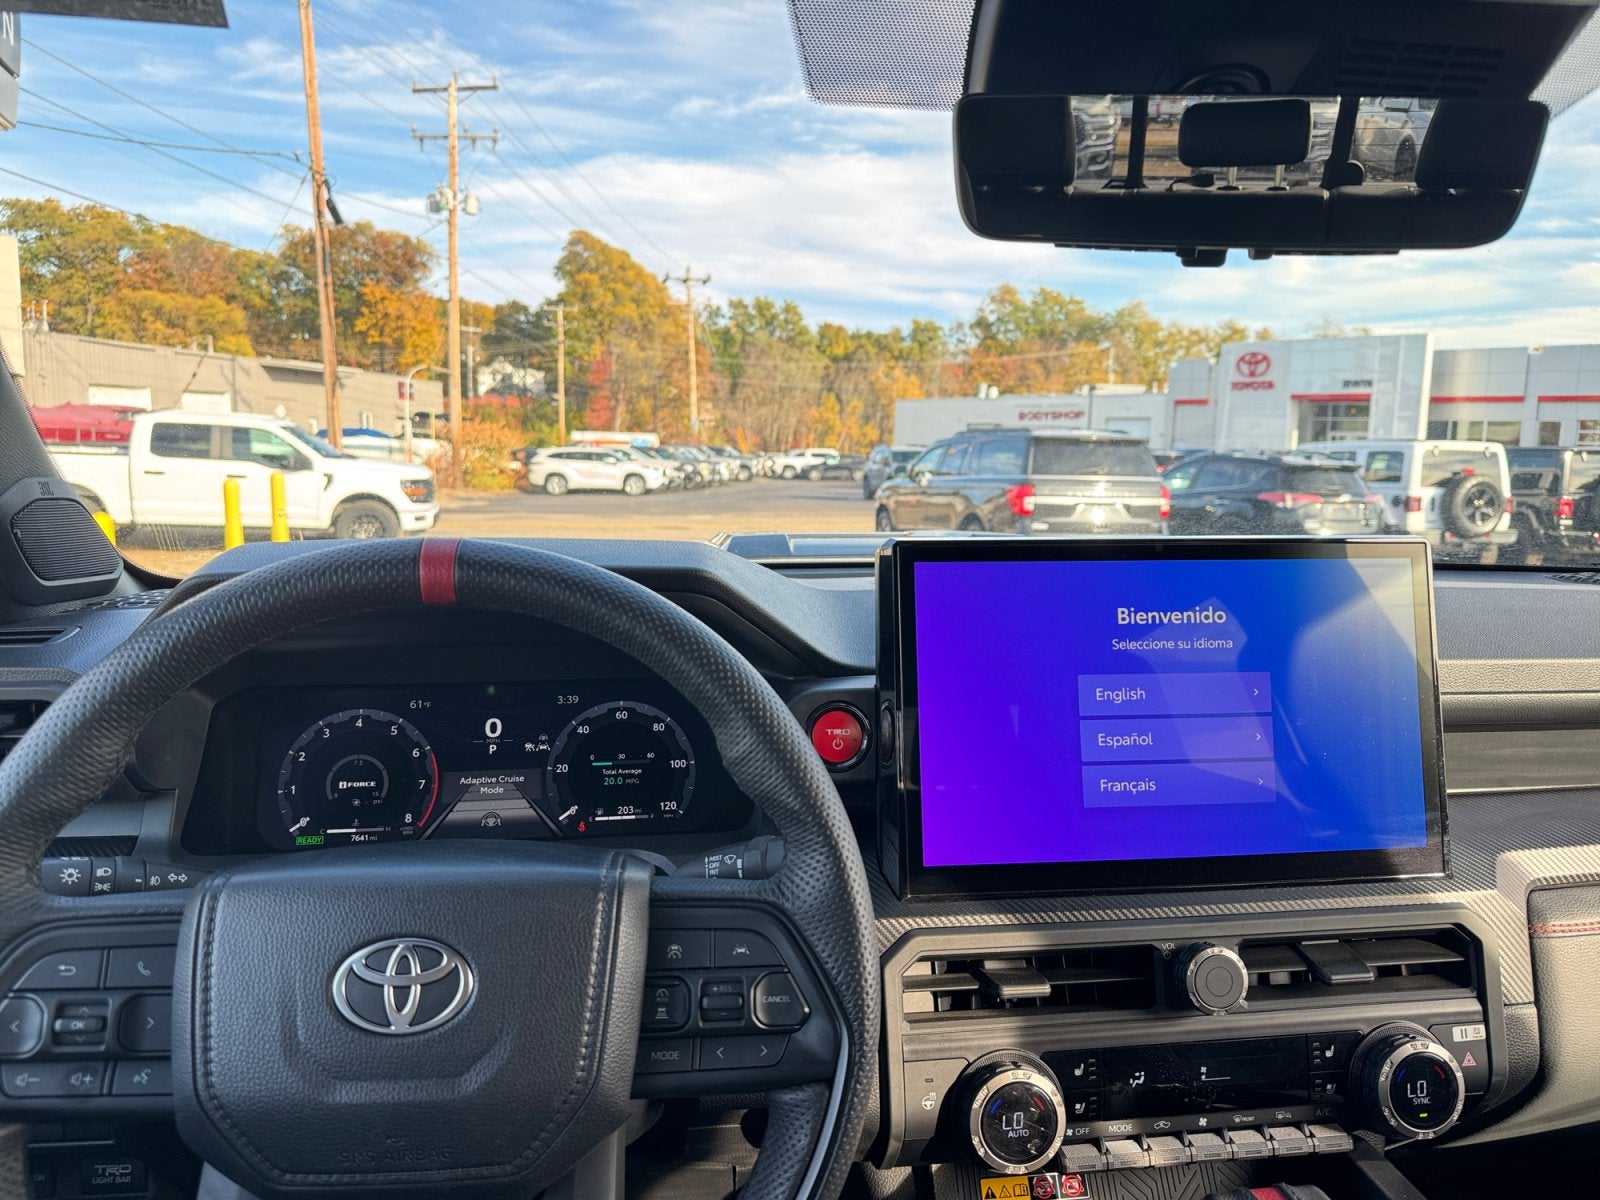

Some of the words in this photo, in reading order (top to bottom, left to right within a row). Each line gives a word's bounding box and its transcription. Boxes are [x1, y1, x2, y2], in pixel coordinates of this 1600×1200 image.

[1232, 380, 1274, 390] TOYOTA
[1117, 606, 1226, 624] Bienvenido
[1112, 638, 1174, 650] Seleccione
[1178, 640, 1191, 648] su
[1194, 638, 1233, 648] idioma
[557, 696, 579, 704] 3:39
[1096, 688, 1146, 704] English
[616, 711, 628, 720] 60
[355, 718, 363, 728] 4
[652, 722, 665, 732] 80
[390, 726, 398, 736] 5
[484, 718, 502, 738] 0
[576, 726, 590, 734] 40
[322, 728, 330, 738] 3
[1098, 732, 1153, 748] Español
[412, 748, 420, 758] 6
[489, 745, 497, 754] P
[298, 752, 306, 762] 2
[556, 764, 568, 772] 20
[670, 760, 687, 768] 100
[418, 780, 426, 790] 7
[460, 776, 497, 786] Adaptive
[498, 775, 525, 783] Cruise
[604, 778, 623, 786] 20.0
[290, 785, 296, 794] 1
[480, 786, 504, 794] Mode
[1100, 779, 1156, 794] Français
[618, 806, 634, 814] 203
[660, 802, 677, 810] 120
[404, 814, 412, 823] 8
[296, 836, 324, 844] READY
[350, 834, 369, 842] 7641
[1161, 942, 1176, 950] VOL
[71, 1020, 86, 1030] OK
[652, 1050, 680, 1060] MODE
[1412, 1096, 1432, 1106] SYNC
[1316, 1108, 1330, 1116] A/C
[1075, 1127, 1090, 1136] OFF
[1108, 1124, 1133, 1133] MODE
[1008, 1129, 1030, 1138] AUTO
[94, 1164, 132, 1176] TRD
[92, 1176, 114, 1184] LIGHT
[115, 1175, 132, 1184] BAR
